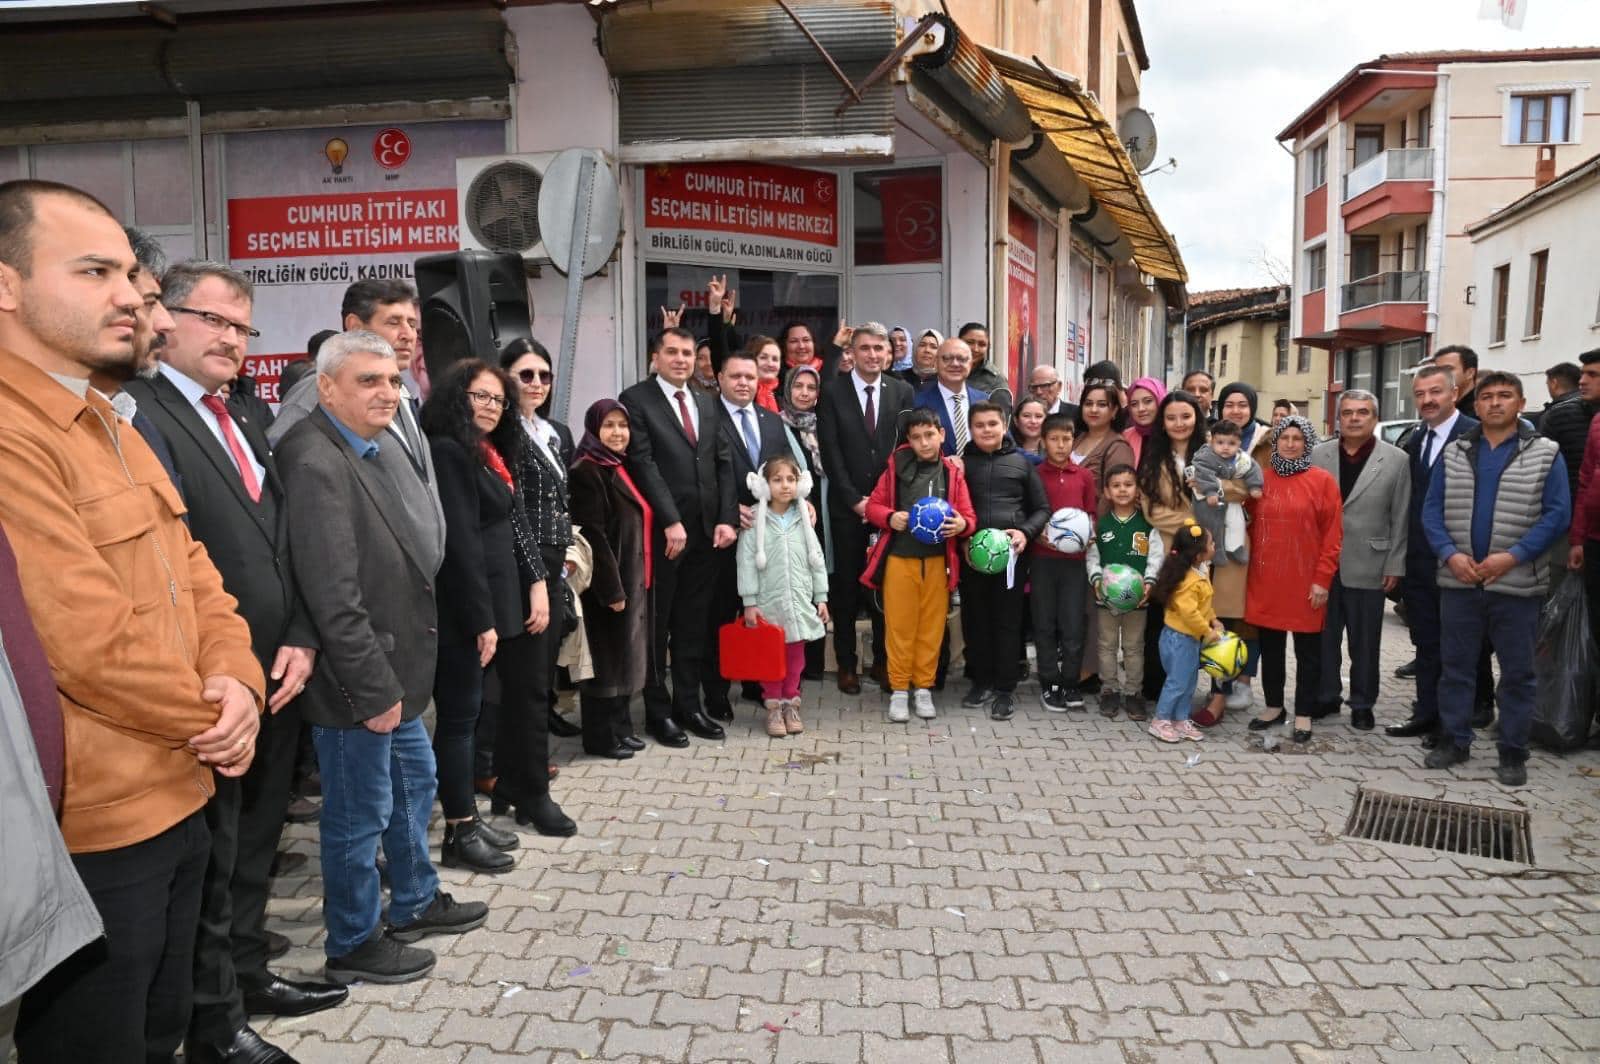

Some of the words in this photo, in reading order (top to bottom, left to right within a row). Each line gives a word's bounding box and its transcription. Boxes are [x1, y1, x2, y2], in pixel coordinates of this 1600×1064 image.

[685, 172, 745, 196] CUMHUR
[748, 176, 804, 204] İTTİFAKI
[287, 203, 363, 224] CUMHUR
[367, 197, 446, 221] İTTİFAKI
[651, 197, 711, 222] SEÇMEN
[715, 200, 774, 229] İLETİŞİM
[777, 212, 833, 235] MERKEZİ
[247, 230, 320, 253] SEÇMEN
[324, 223, 402, 248] İLETİŞİM
[408, 224, 460, 246] MERK
[652, 231, 702, 252] BİRLİĞİN
[705, 237, 737, 257] GÜCÜ,
[740, 243, 804, 261] KADINLARIN
[806, 248, 833, 264] GÜCÜ
[310, 262, 354, 283] GÜCÜ,
[358, 262, 415, 280] KADINL
